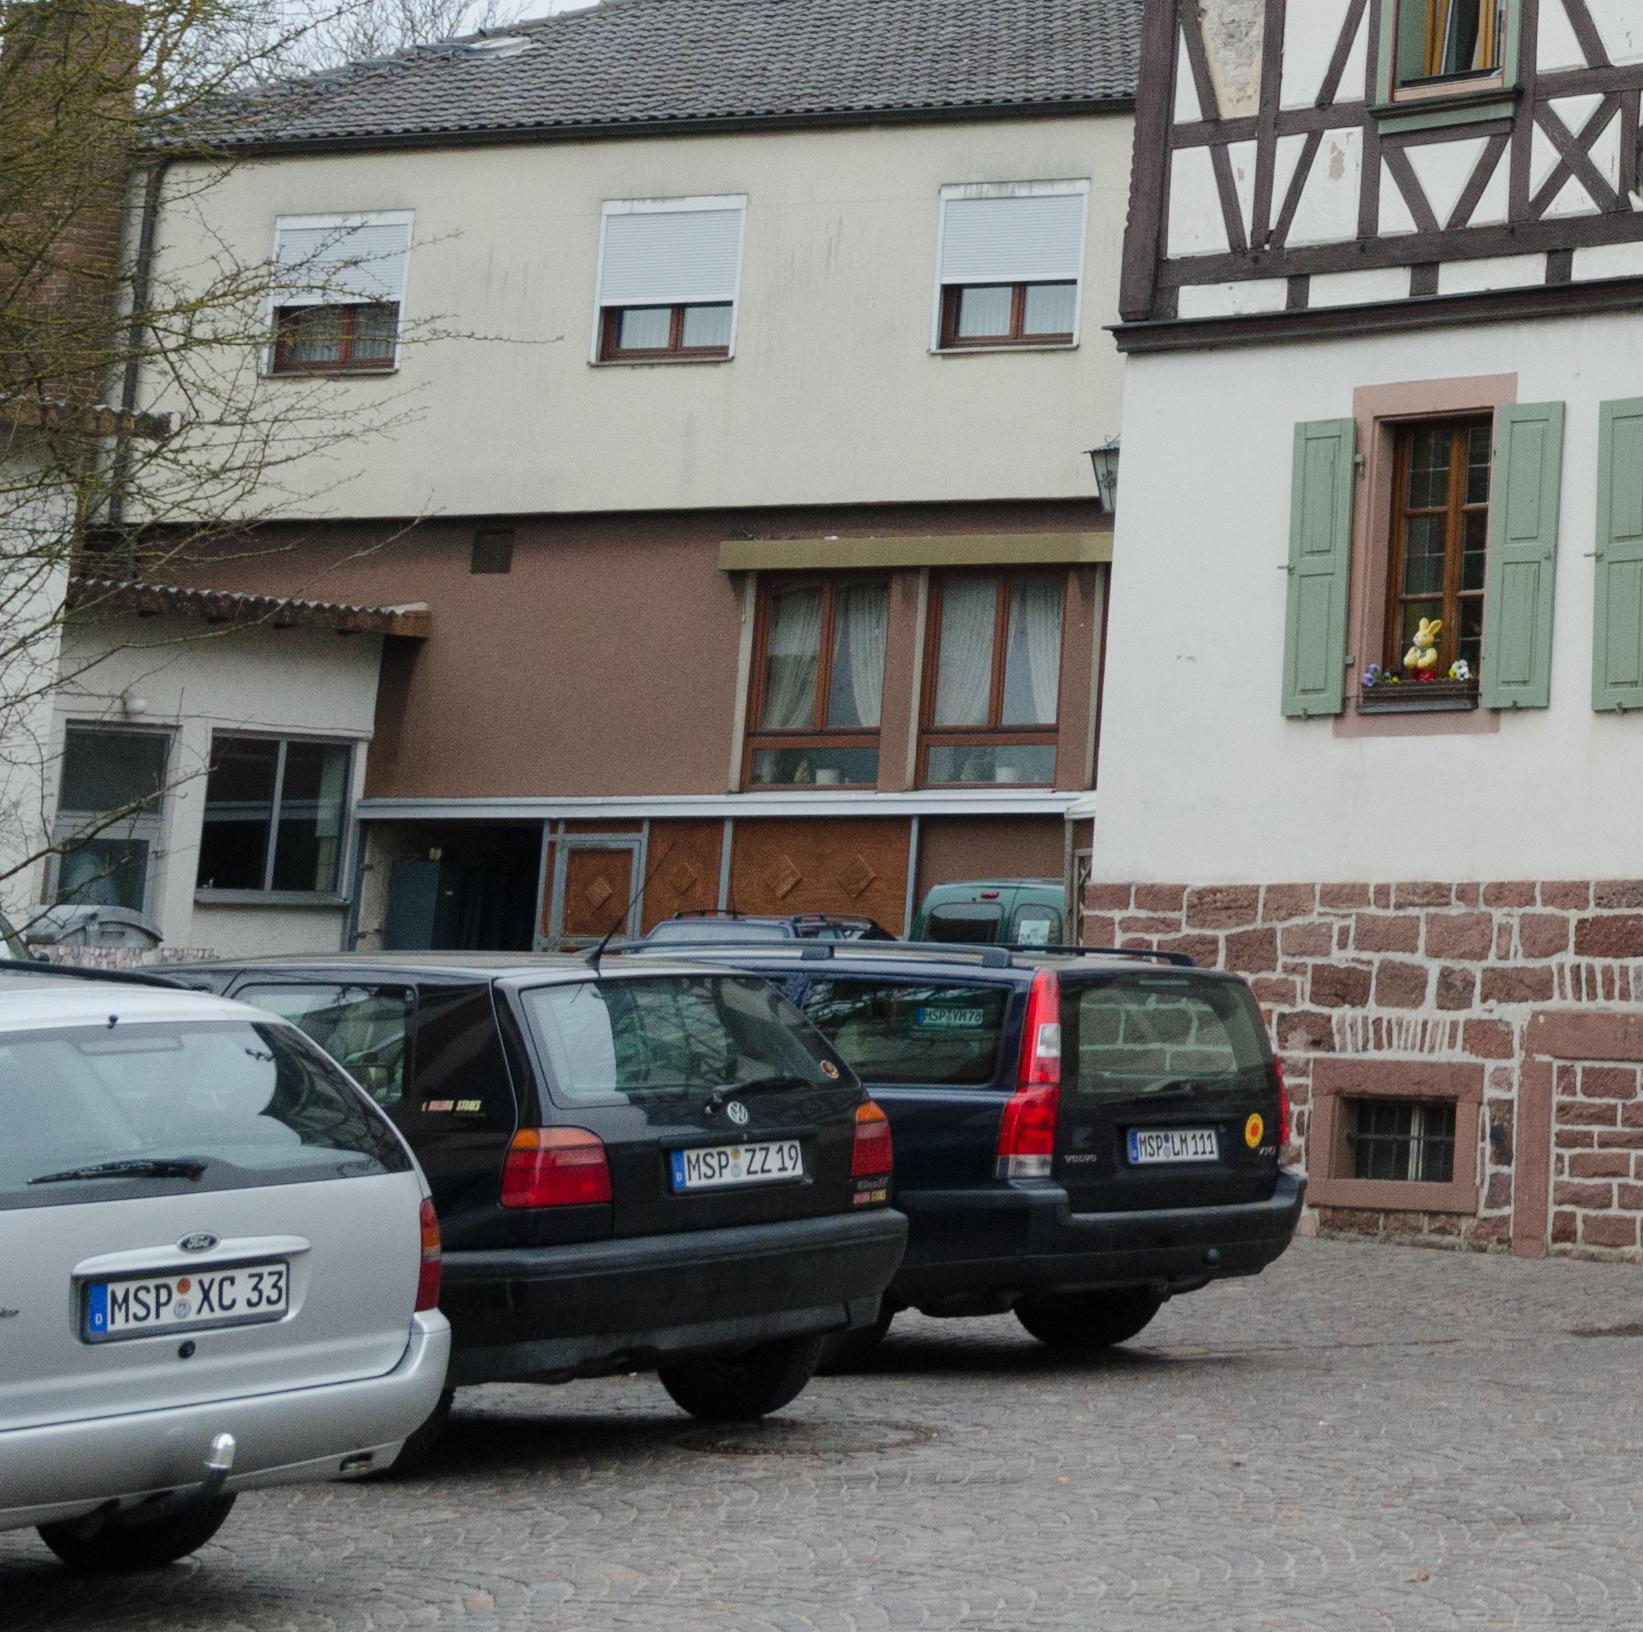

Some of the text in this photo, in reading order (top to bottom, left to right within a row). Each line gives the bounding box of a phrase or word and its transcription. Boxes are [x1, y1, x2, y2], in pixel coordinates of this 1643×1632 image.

[1064, 1154, 1097, 1164] VOLVO
[1139, 1135, 1163, 1158] MSP
[1171, 1132, 1190, 1156] LM
[1192, 1132, 1216, 1156] 111
[686, 1150, 730, 1182] MSP
[744, 1147, 772, 1175] ZZ
[776, 1144, 799, 1172] 19
[110, 1282, 173, 1325] MSP
[196, 1276, 237, 1315] XC
[246, 1270, 284, 1308] 33
